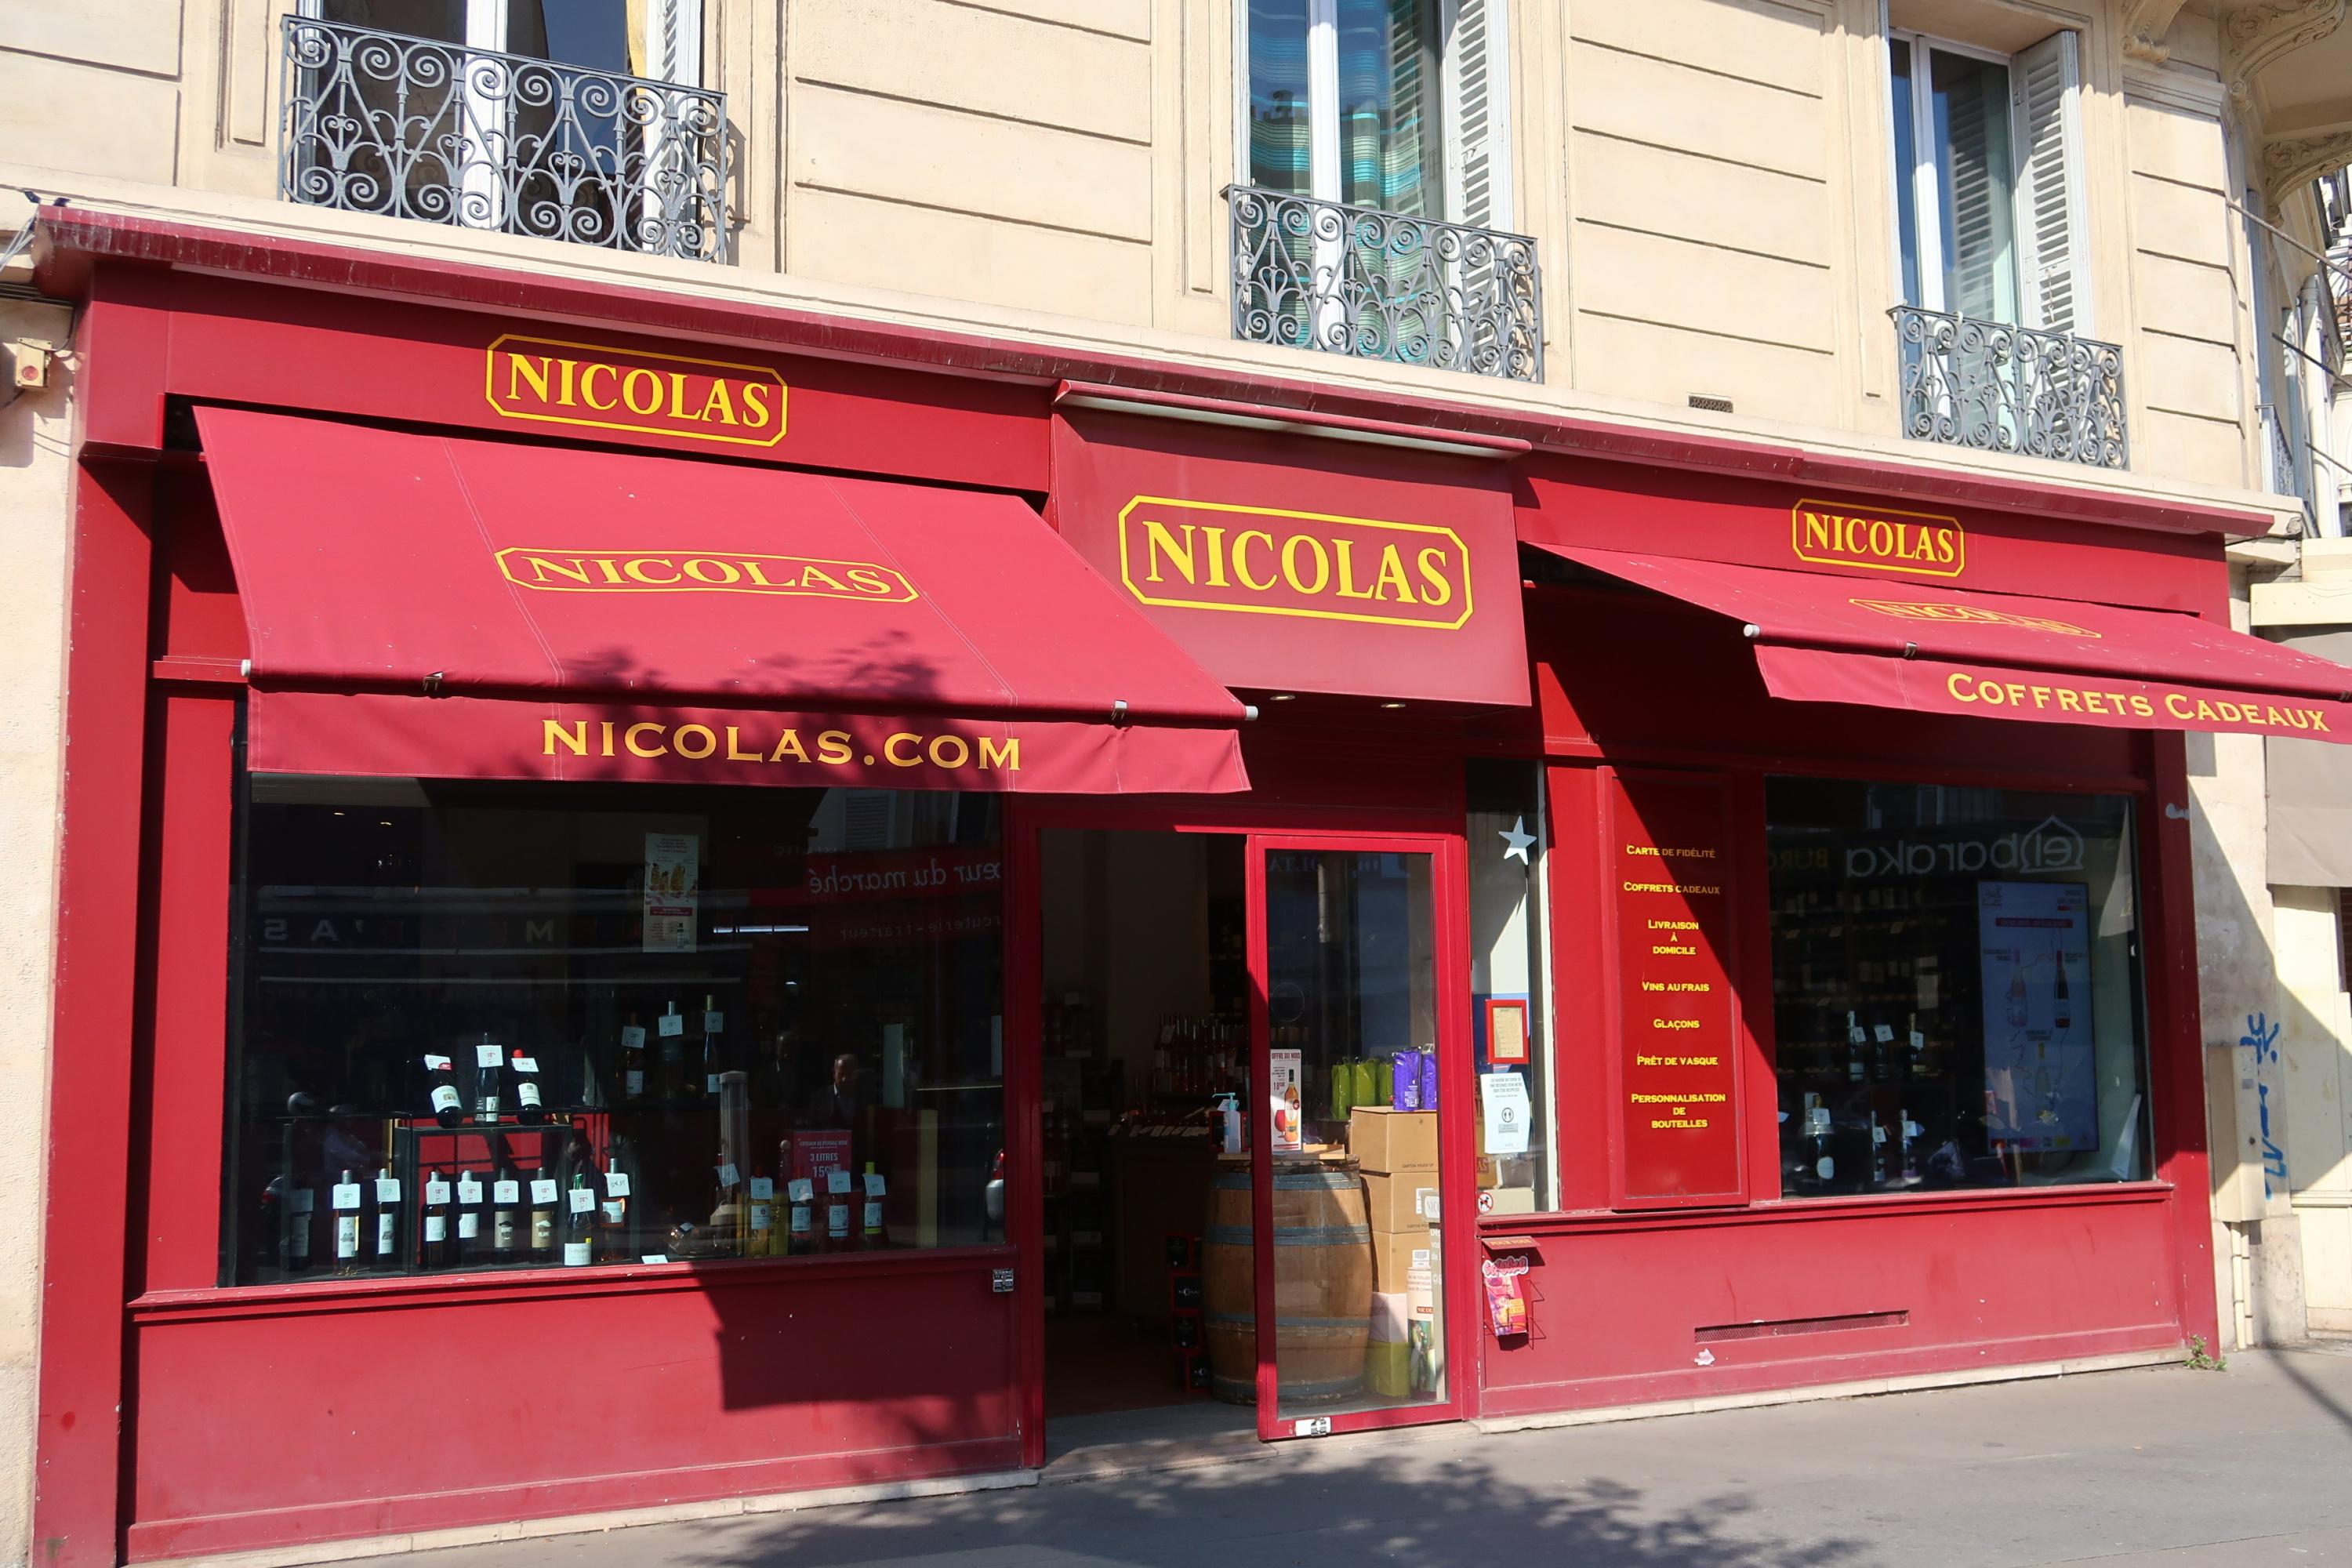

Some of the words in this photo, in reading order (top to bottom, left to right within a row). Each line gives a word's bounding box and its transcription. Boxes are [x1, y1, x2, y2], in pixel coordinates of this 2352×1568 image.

[506, 352, 771, 428] NICOLAS
[1804, 512, 1955, 563] NICOLAS
[1142, 520, 1452, 606] NICOLAS
[521, 556, 892, 594] NICOLAS
[1947, 672, 2154, 717] COFFRETS
[2164, 693, 2332, 732] CADEAUX
[542, 719, 1022, 771] NICOLAS.COM
[1626, 844, 1661, 856] CARTE
[1676, 848, 1716, 858] FIDÉLITÉ
[1624, 880, 1674, 893] COFFRETS
[1675, 885, 1720, 895] CADEAUX
[1648, 919, 1699, 931] LIVRAISON
[1670, 931, 1678, 942] À
[1653, 946, 1696, 955] DOMICILE
[1642, 982, 1664, 992] VINS
[1681, 983, 1710, 992] FRAIS
[1653, 1018, 1700, 1031] GLAÇONS
[1637, 1055, 1662, 1065] PRÊT
[1679, 1057, 1719, 1065] VASQUE
[1632, 1094, 1726, 1103] PERSONNALISATION
[1673, 1107, 1686, 1116] DE
[1651, 1120, 1708, 1128] BOUTEILLES
[810, 1153, 815, 1162] 3
[816, 1152, 839, 1161] LITRES
